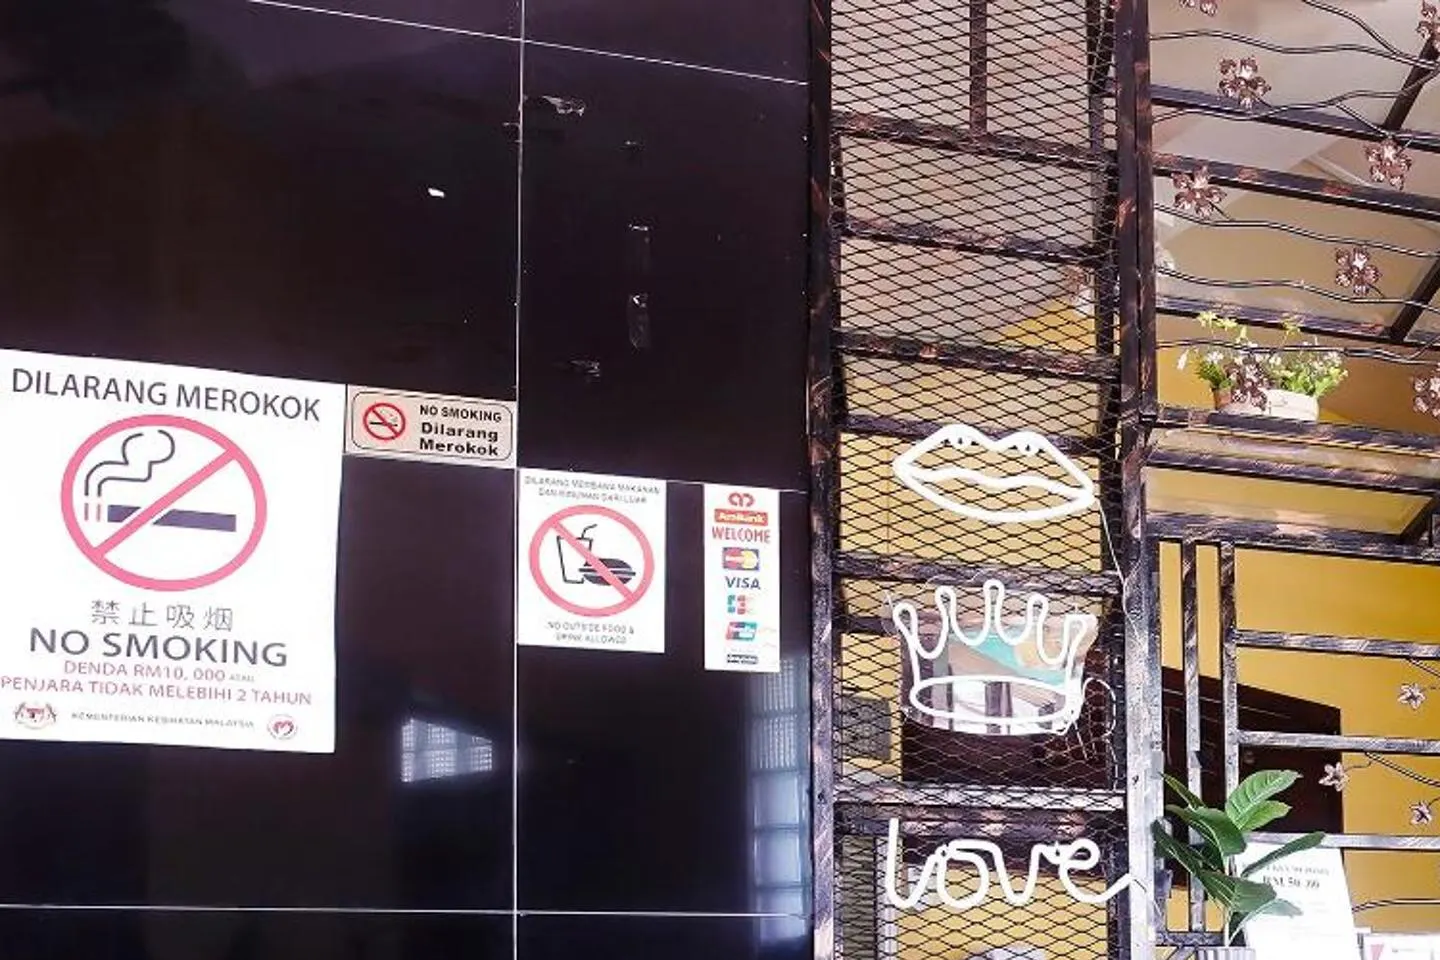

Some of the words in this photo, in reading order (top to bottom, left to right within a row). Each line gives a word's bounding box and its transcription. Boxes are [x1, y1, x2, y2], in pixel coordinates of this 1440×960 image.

[12, 368, 167, 406] DILARANG
[176, 384, 321, 422] MEROKOK
[420, 404, 438, 415] NO
[441, 406, 502, 423] SMOKING
[421, 421, 498, 442] Dilarang
[420, 437, 498, 456] Merokok
[712, 526, 771, 543] WELCOME
[725, 576, 761, 589] VISA
[91, 599, 233, 631] 禁止吸烟
[30, 628, 89, 655] NO
[102, 632, 287, 667] SMOKING
[64, 660, 127, 677] DENDA
[1, 675, 82, 693] PENJARA
[89, 680, 143, 697] TIDAK
[149, 684, 232, 700] MELEBIHI
[236, 688, 247, 701] 2
[251, 688, 312, 706] TAHUN
